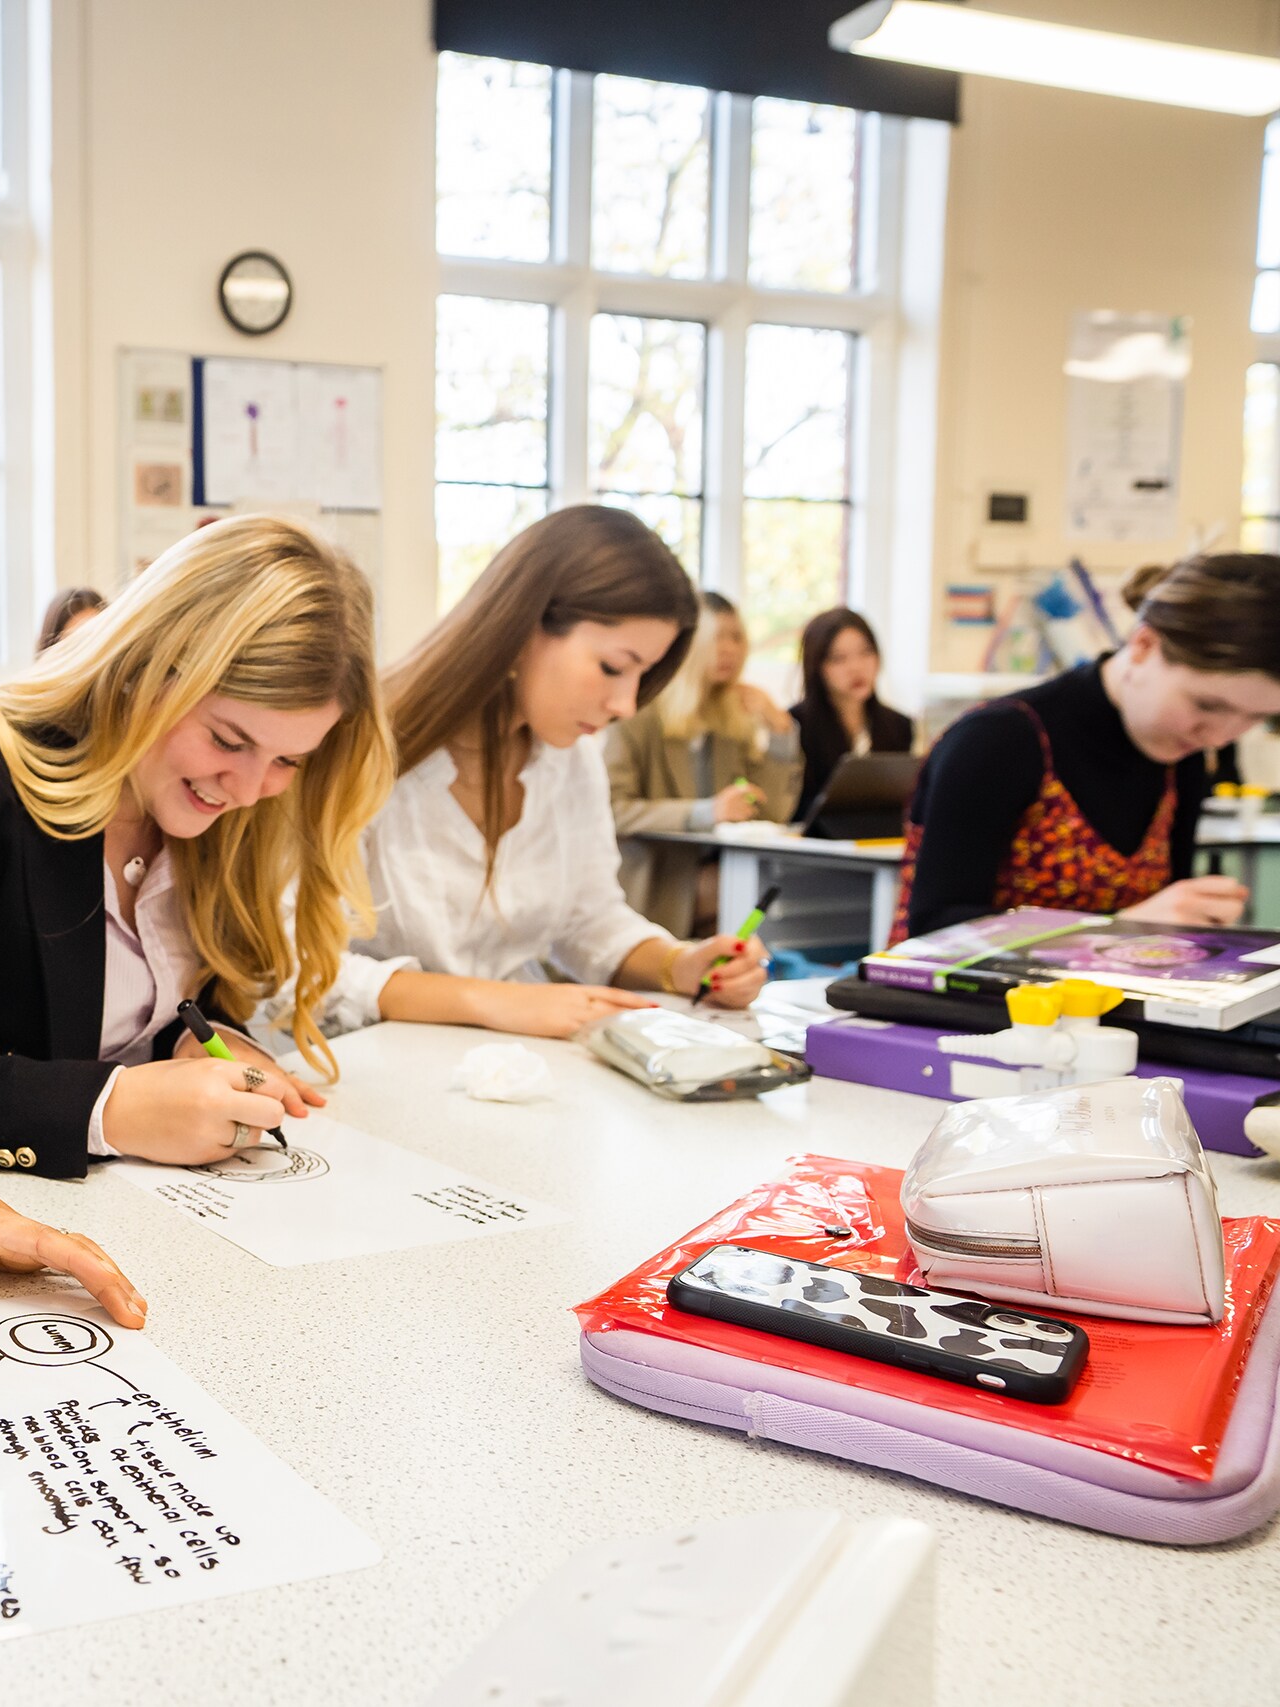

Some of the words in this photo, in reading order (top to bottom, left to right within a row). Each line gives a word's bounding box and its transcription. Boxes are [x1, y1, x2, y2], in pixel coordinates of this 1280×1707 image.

[132, 1393, 217, 1459] epithelium
[33, 1434, 69, 1470] blood
[64, 1480, 93, 1508] cells
[130, 1439, 176, 1478] tissue
[168, 1482, 214, 1516] made
[215, 1525, 240, 1546] up
[90, 1480, 148, 1534] support
[154, 1555, 181, 1578] so
[179, 1529, 219, 1570] cells
